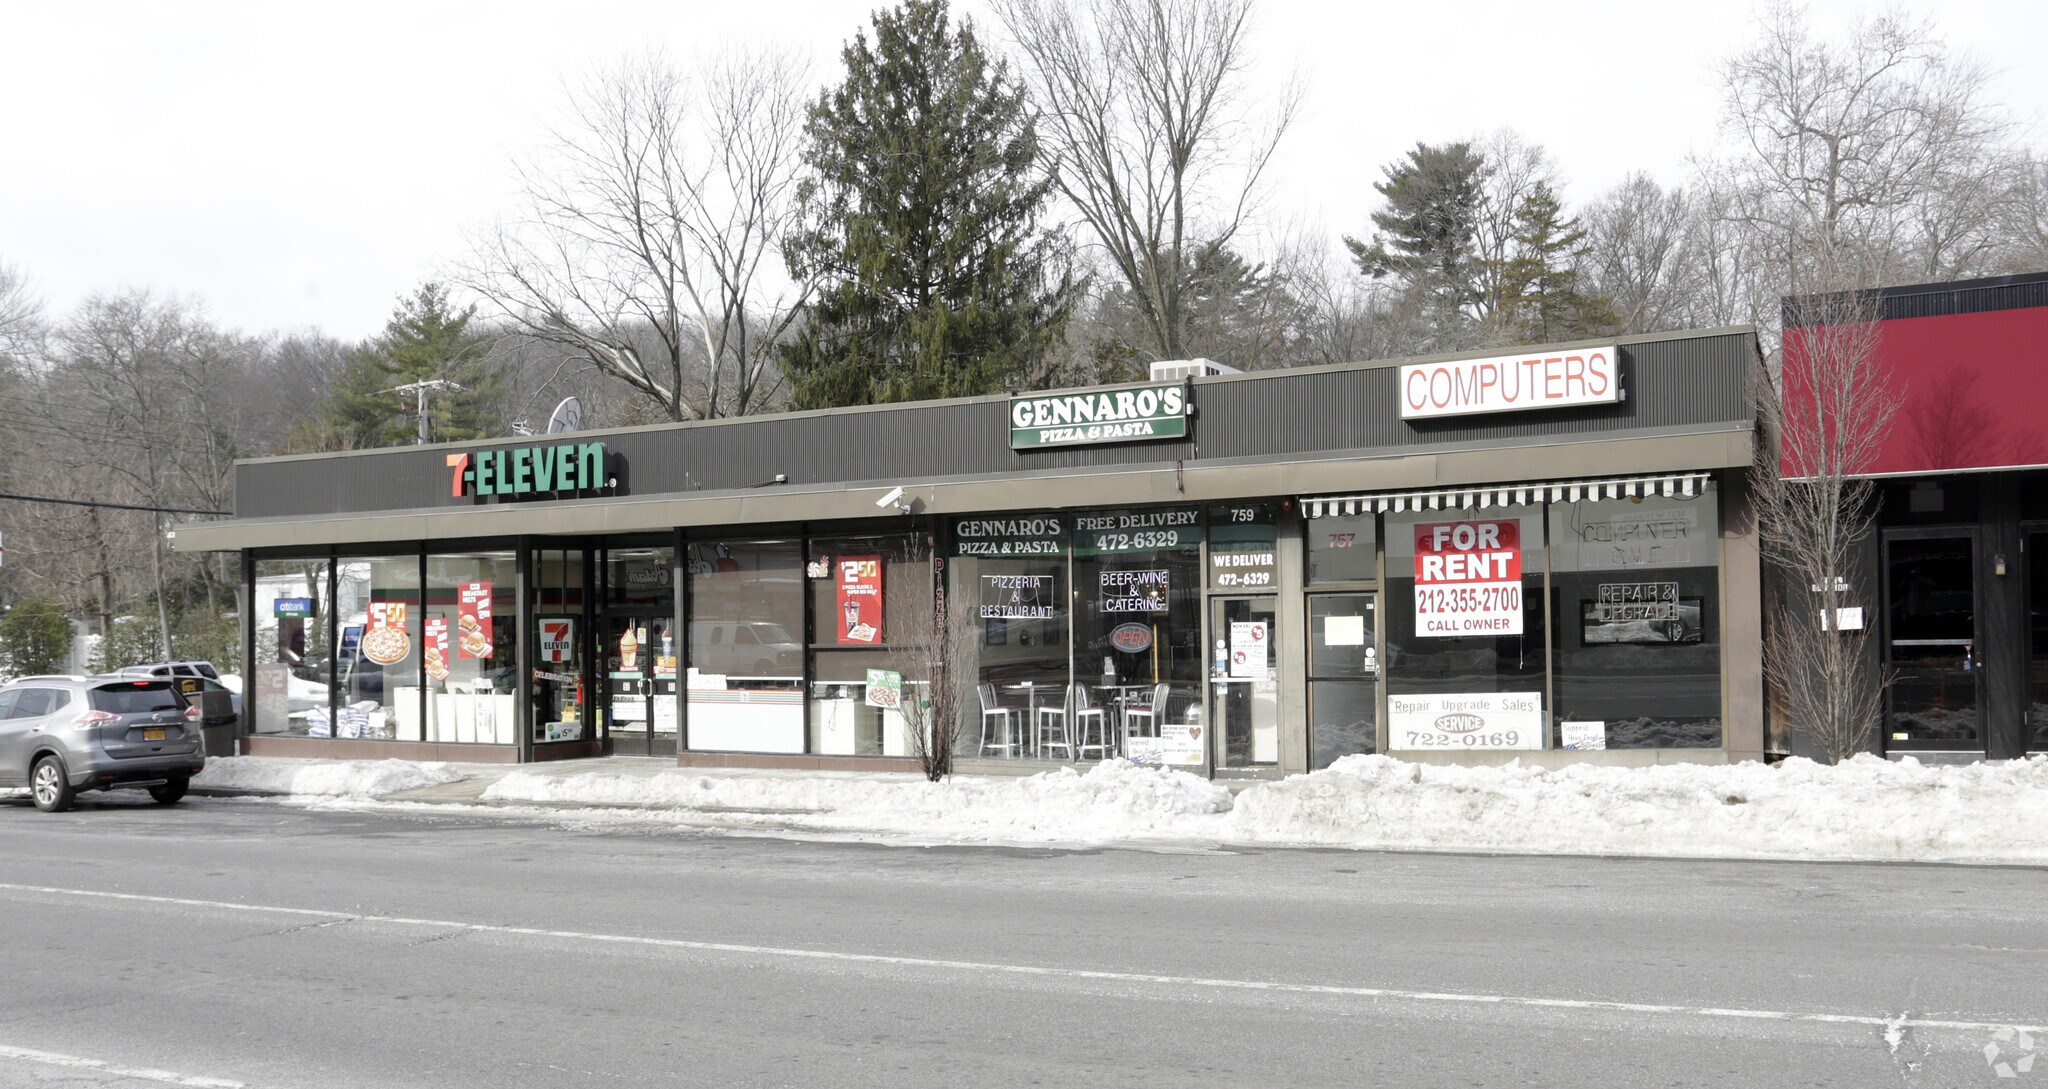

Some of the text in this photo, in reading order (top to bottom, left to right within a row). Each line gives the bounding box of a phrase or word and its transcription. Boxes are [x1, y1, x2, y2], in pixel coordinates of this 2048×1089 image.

[1407, 353, 1608, 410] COMPUTERS
[1012, 387, 1182, 428] GENNARO'S
[1040, 421, 1154, 443] PIZZA & PASTA
[1077, 511, 1198, 530] FREE DELIVERY
[1231, 509, 1254, 522] 759
[957, 519, 1061, 537] GENNARO'S
[1097, 530, 1178, 550] 472-6329
[1329, 533, 1356, 548] 757
[1433, 523, 1501, 552] FOR
[959, 541, 1059, 554] PIZZA & PASTA
[1214, 553, 1274, 567] WE DELIVER
[1422, 552, 1513, 581] RENT
[991, 576, 1040, 588] PIZZERIA
[1100, 571, 1168, 586] BEER-WINE
[1218, 572, 1270, 585] 472-6329
[1012, 591, 1019, 602] &
[1129, 583, 1139, 597] &
[1602, 585, 1674, 600] REPAIR &
[280, 602, 304, 611] citibank
[1106, 598, 1165, 611] CATERING
[1418, 587, 1519, 613] 212-355-2700
[981, 605, 1052, 617] RESTAURANT
[1427, 618, 1510, 631] CALL OWNER
[1114, 630, 1150, 645] OPEN
[534, 670, 574, 683] CELEBRATION
[1395, 699, 1534, 714] Repair Upgrade Sales
[1437, 716, 1482, 731] SERVICE
[1563, 723, 1588, 732] Support
[1406, 731, 1519, 746] 722-0169
